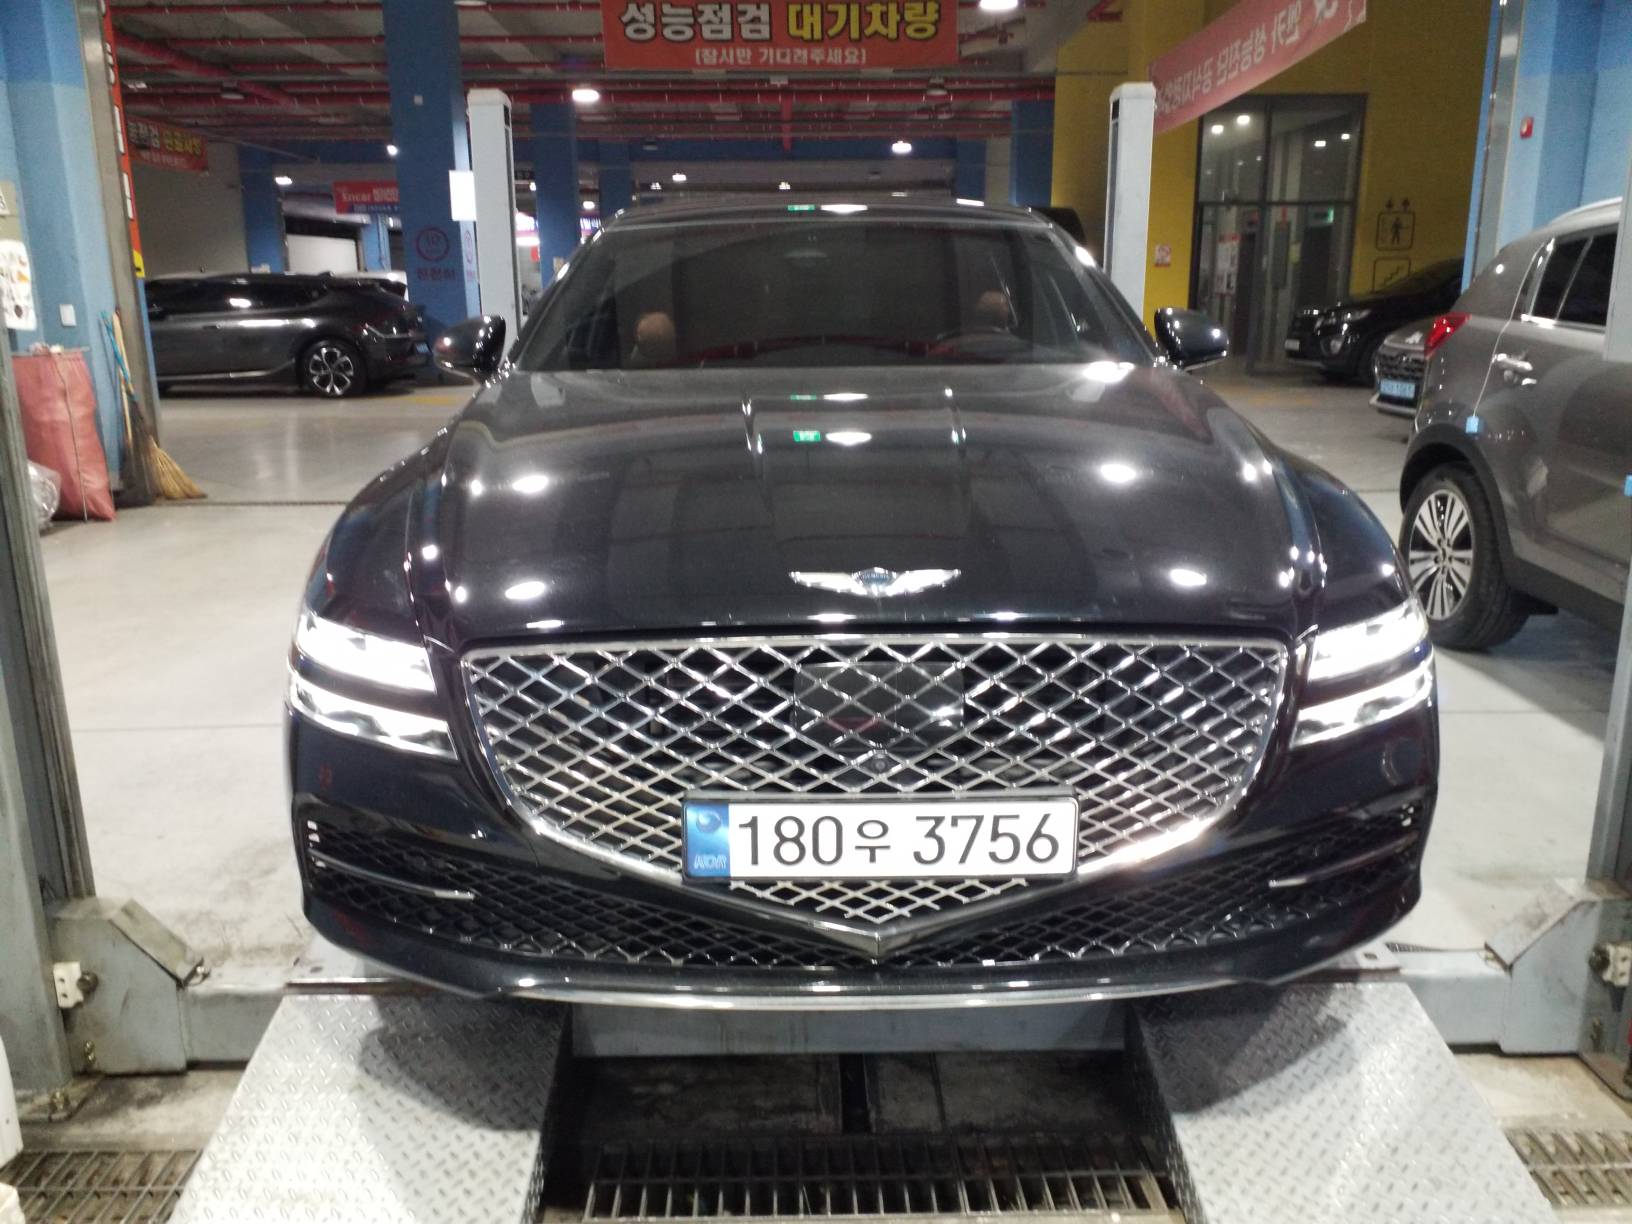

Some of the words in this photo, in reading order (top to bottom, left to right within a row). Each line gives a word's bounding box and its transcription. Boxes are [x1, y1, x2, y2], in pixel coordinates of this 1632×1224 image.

[621, 1, 771, 41] 성능점검
[787, 1, 940, 41] 대기차량
[738, 815, 891, 866] 180우
[912, 812, 1061, 866] 3756
